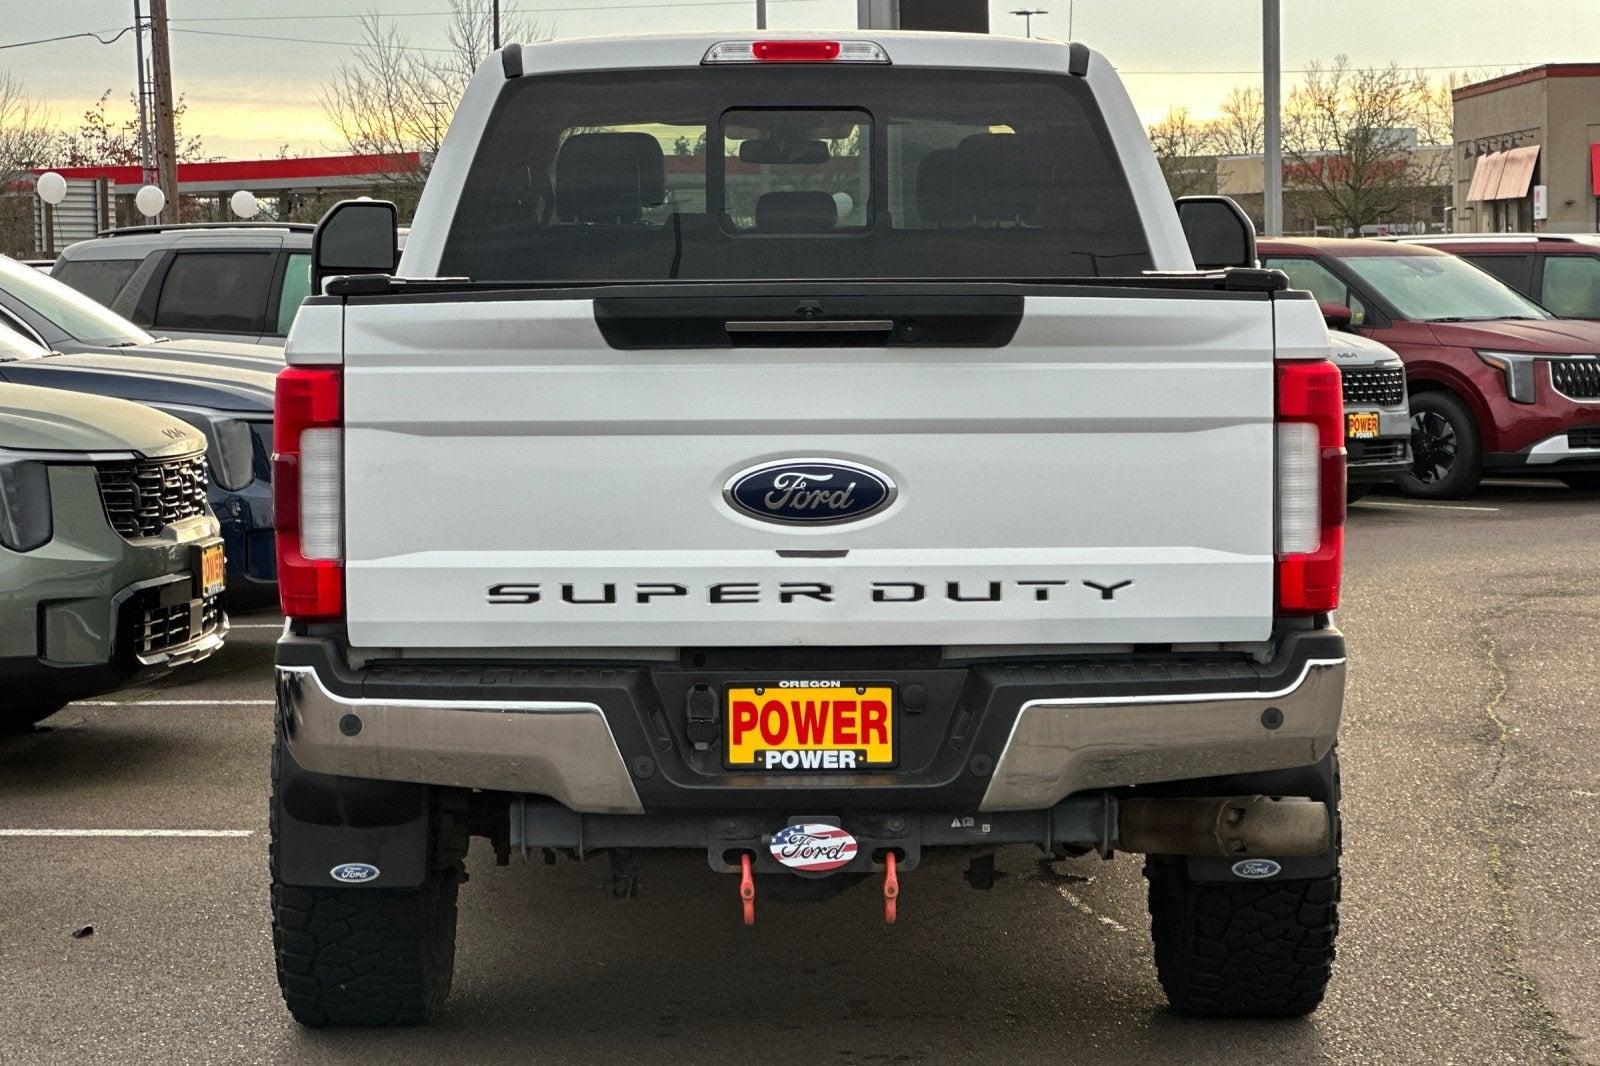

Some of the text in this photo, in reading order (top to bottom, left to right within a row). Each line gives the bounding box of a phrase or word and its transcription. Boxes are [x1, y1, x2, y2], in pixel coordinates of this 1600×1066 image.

[1349, 418, 1377, 432] POWER
[764, 472, 856, 510] Ford
[488, 579, 1135, 604] SUPER DUTY
[778, 680, 841, 688] OREGON
[732, 699, 889, 746] POWER
[765, 750, 856, 770] POWER
[781, 833, 846, 860] Ford
[341, 867, 369, 878] Ford
[1243, 863, 1269, 874] Ford
